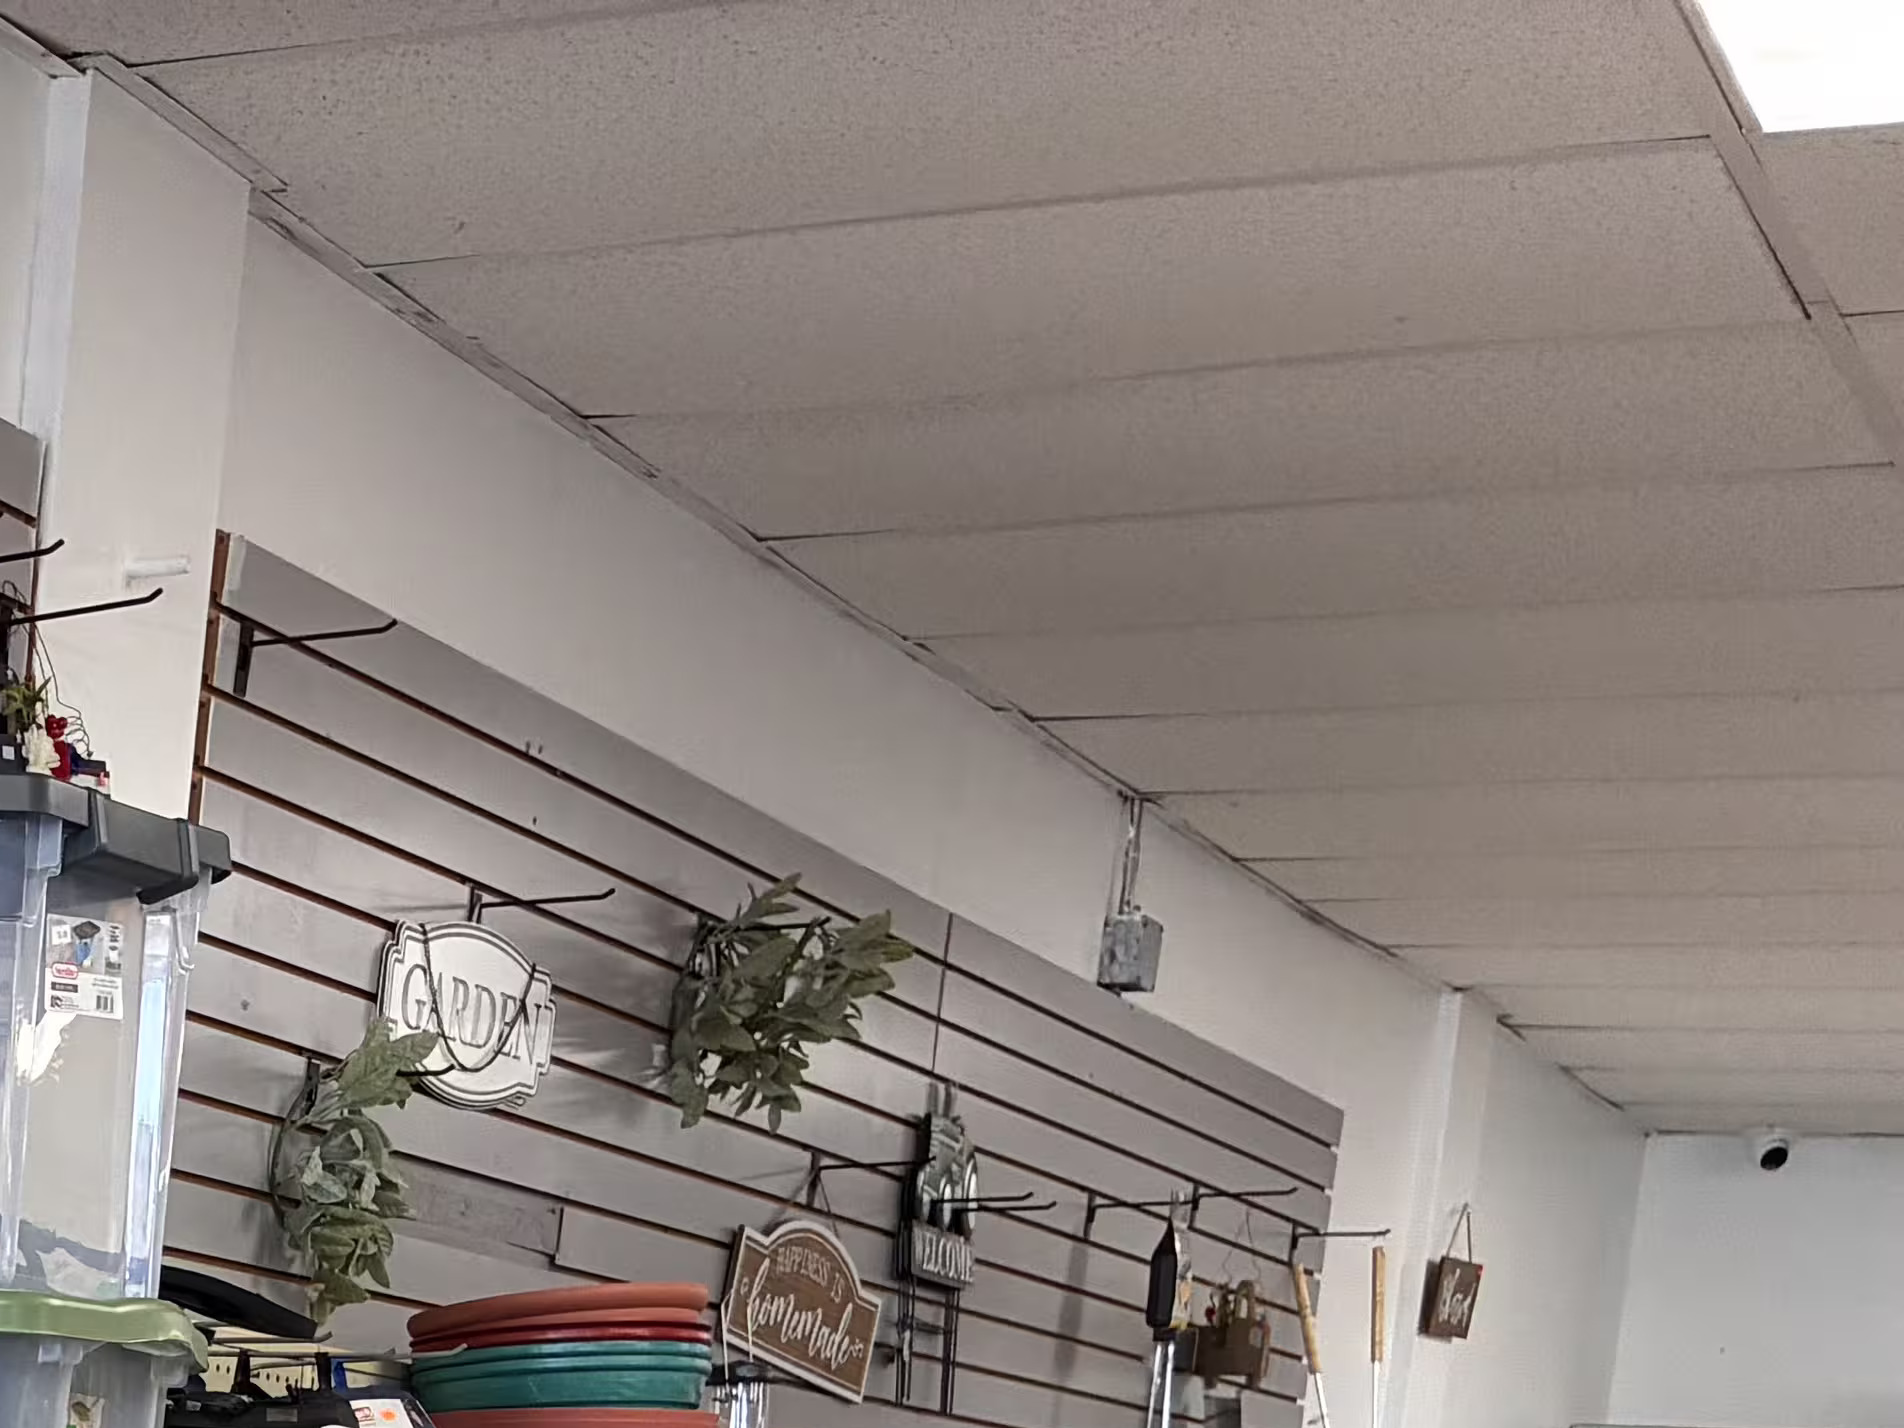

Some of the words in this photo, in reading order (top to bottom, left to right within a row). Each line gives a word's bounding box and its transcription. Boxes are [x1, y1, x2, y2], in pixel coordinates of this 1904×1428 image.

[400, 961, 555, 1067] GARDEN
[746, 1256, 851, 1371] homemade
[775, 1244, 832, 1288] HAPPINESS
[830, 1272, 846, 1303] IS
